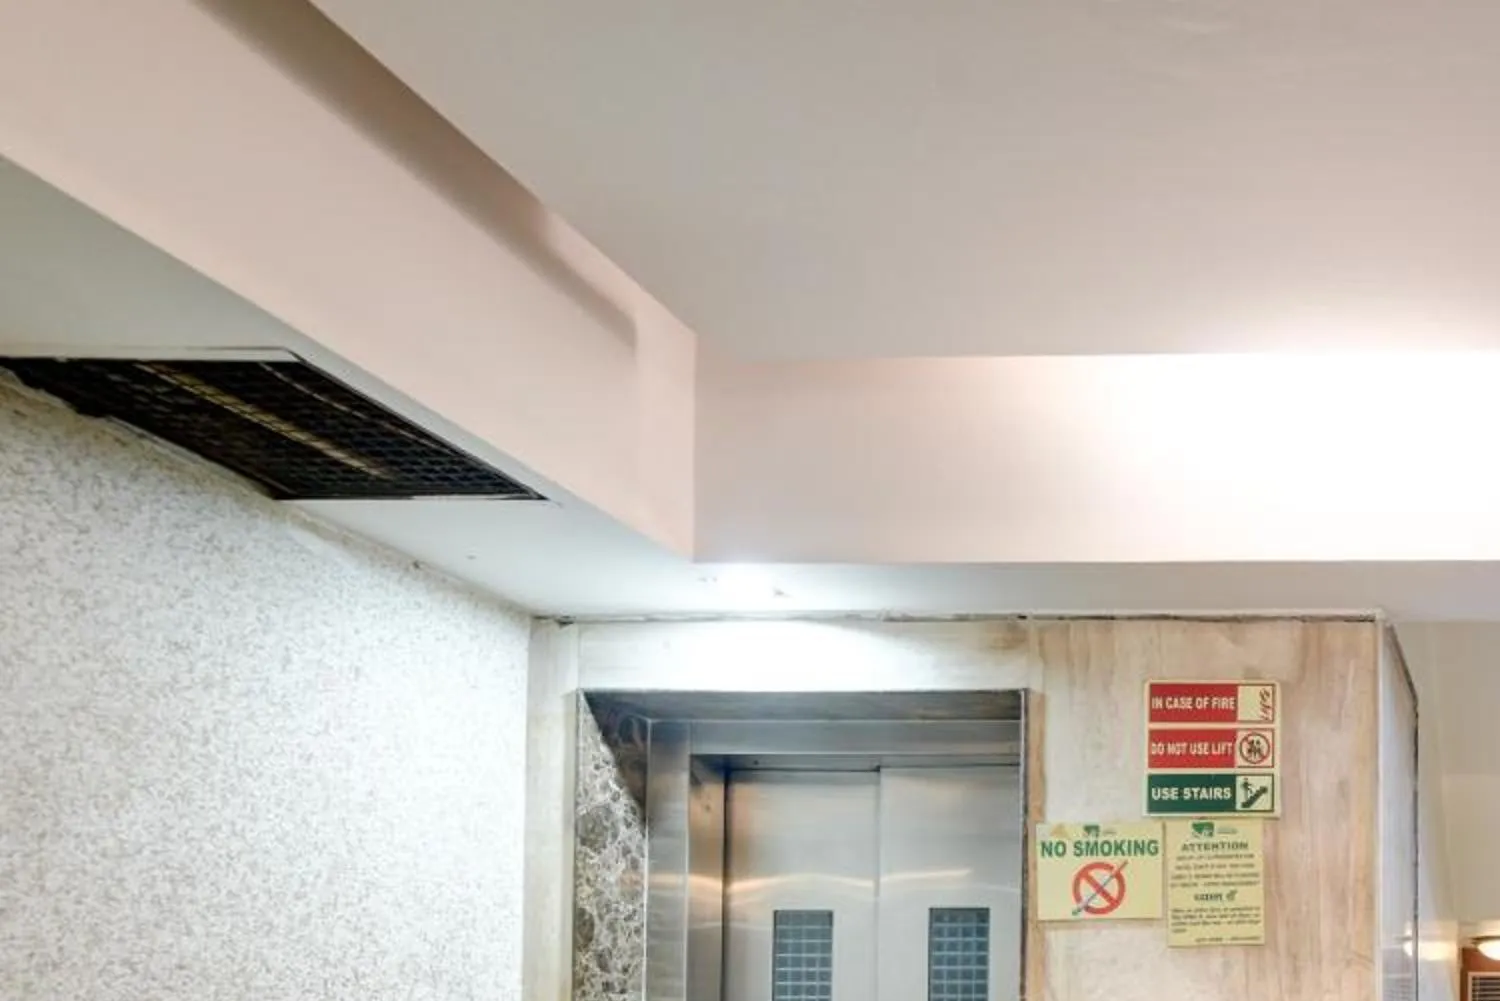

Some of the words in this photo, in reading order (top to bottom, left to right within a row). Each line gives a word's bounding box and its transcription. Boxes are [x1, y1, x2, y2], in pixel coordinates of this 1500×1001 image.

[1152, 697, 1163, 709] IN
[1165, 697, 1193, 709] CASE
[1195, 697, 1209, 709] OF
[1212, 697, 1235, 709] FIRE
[1151, 742, 1165, 754] DO
[1167, 742, 1187, 754] NOT
[1190, 742, 1209, 754] USE
[1212, 742, 1232, 754] LIFT
[1151, 787, 1178, 800] USE
[1183, 787, 1231, 800] STAIRS
[1040, 840, 1066, 857] NO
[1073, 839, 1159, 856] SMOKING
[1181, 841, 1249, 852] ATTENTION
